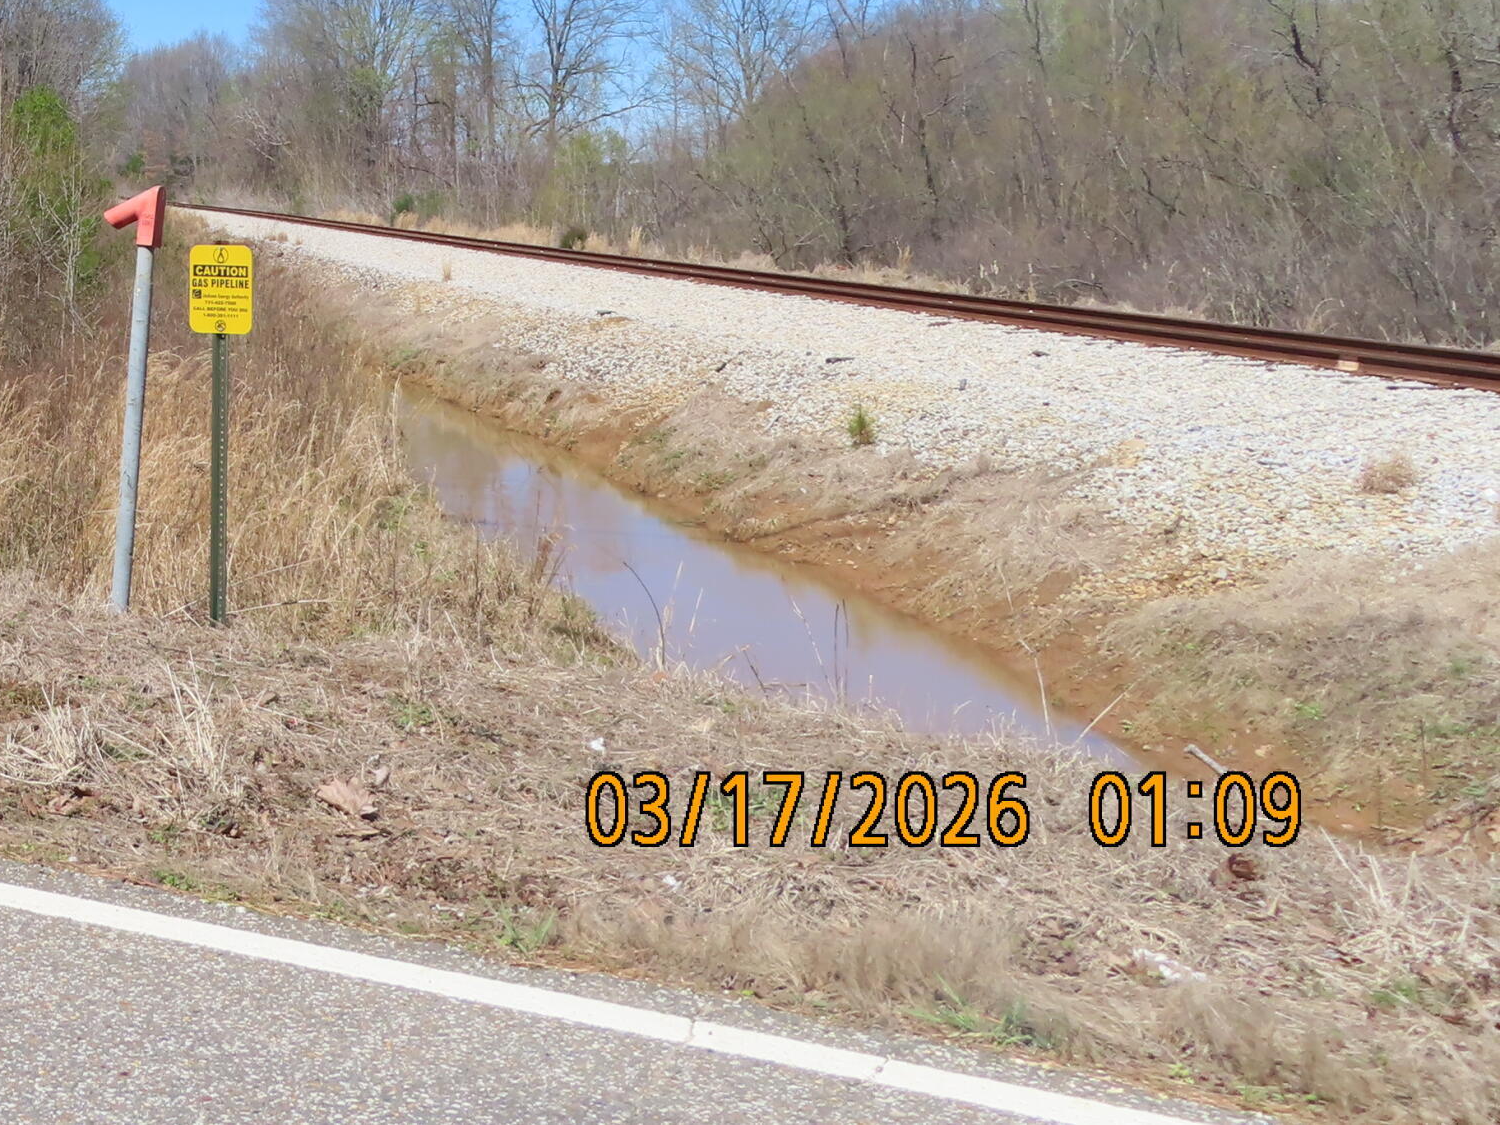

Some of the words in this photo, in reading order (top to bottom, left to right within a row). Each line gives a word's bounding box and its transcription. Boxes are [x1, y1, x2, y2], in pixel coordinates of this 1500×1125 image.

[195, 265, 247, 277] CAUTION
[192, 278, 209, 288] GAS
[211, 278, 250, 289] PIPELINE
